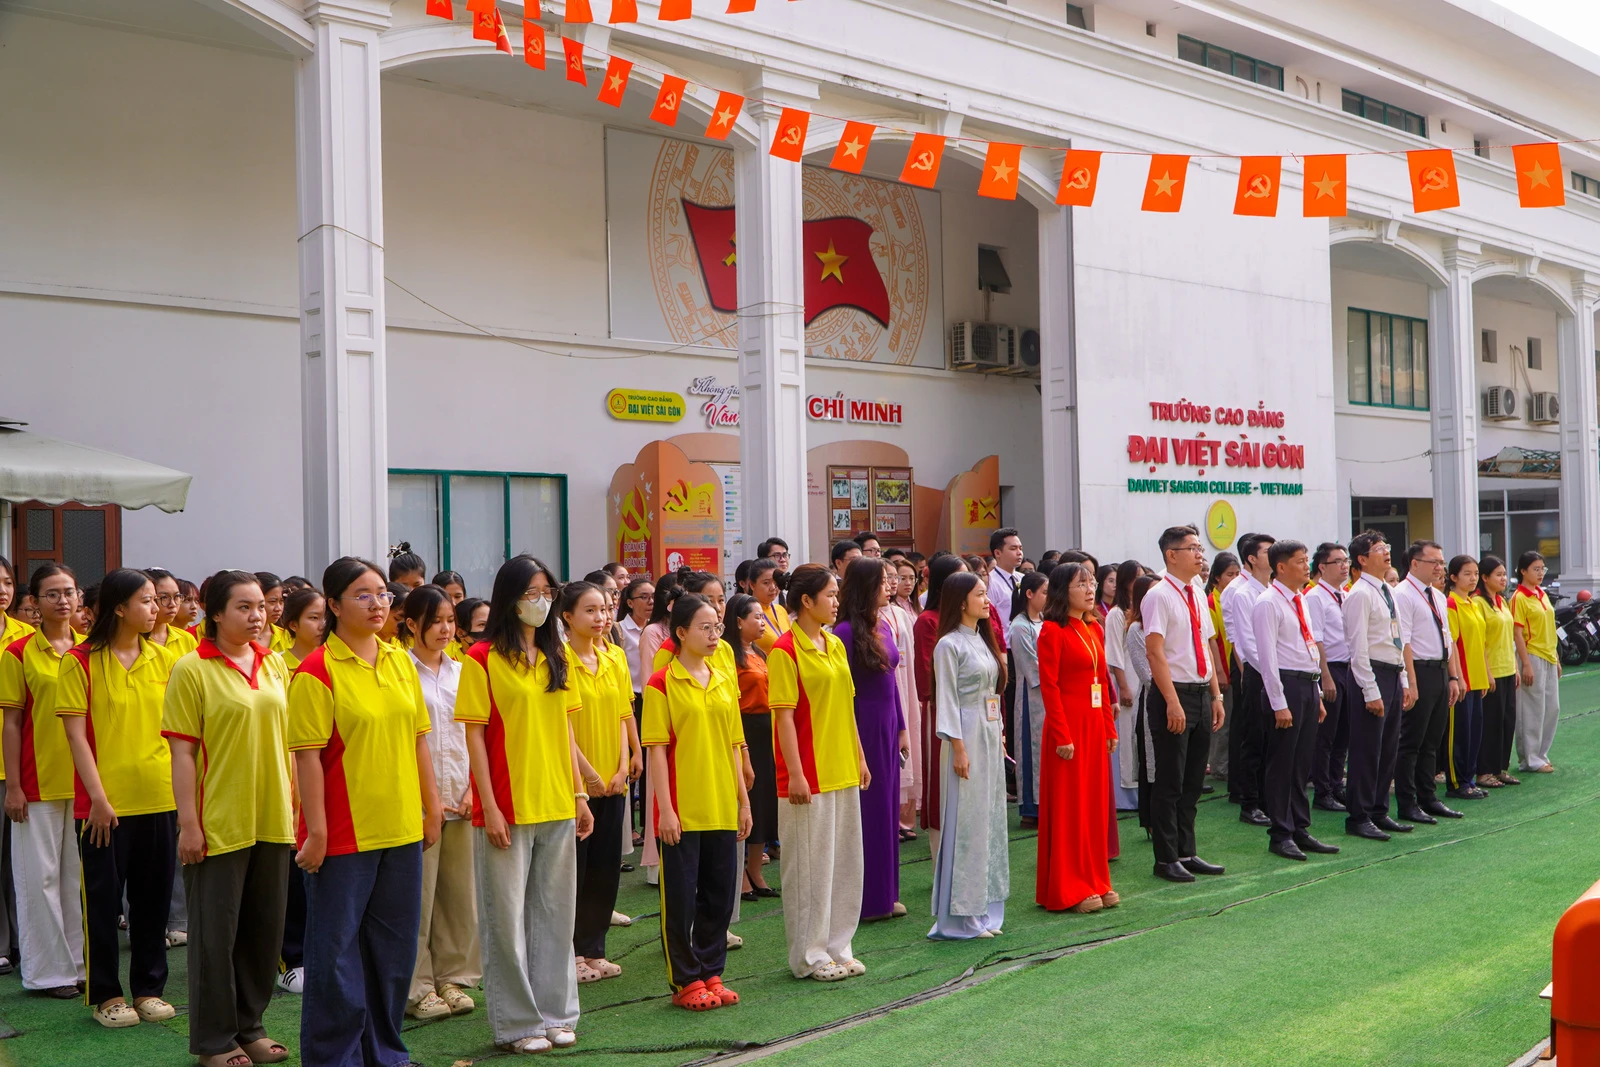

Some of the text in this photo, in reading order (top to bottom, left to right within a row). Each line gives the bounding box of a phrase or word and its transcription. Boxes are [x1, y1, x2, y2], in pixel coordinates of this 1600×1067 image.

[692, 377, 740, 404] Không gia
[628, 403, 681, 416] ĐẠI VIỆT SÀI GÒN
[705, 392, 902, 426] Văn CHÍ MINH
[1149, 398, 1284, 428] TRƯỜNG CAO ĐẲNG
[1126, 431, 1305, 476] ĐẠI VIỆT SÀI GÒN
[1127, 478, 1169, 493] DAIVIET
[1170, 479, 1210, 494] SAIGON
[1210, 480, 1252, 494] COLLEGE
[1260, 482, 1303, 496] VIETNAM
